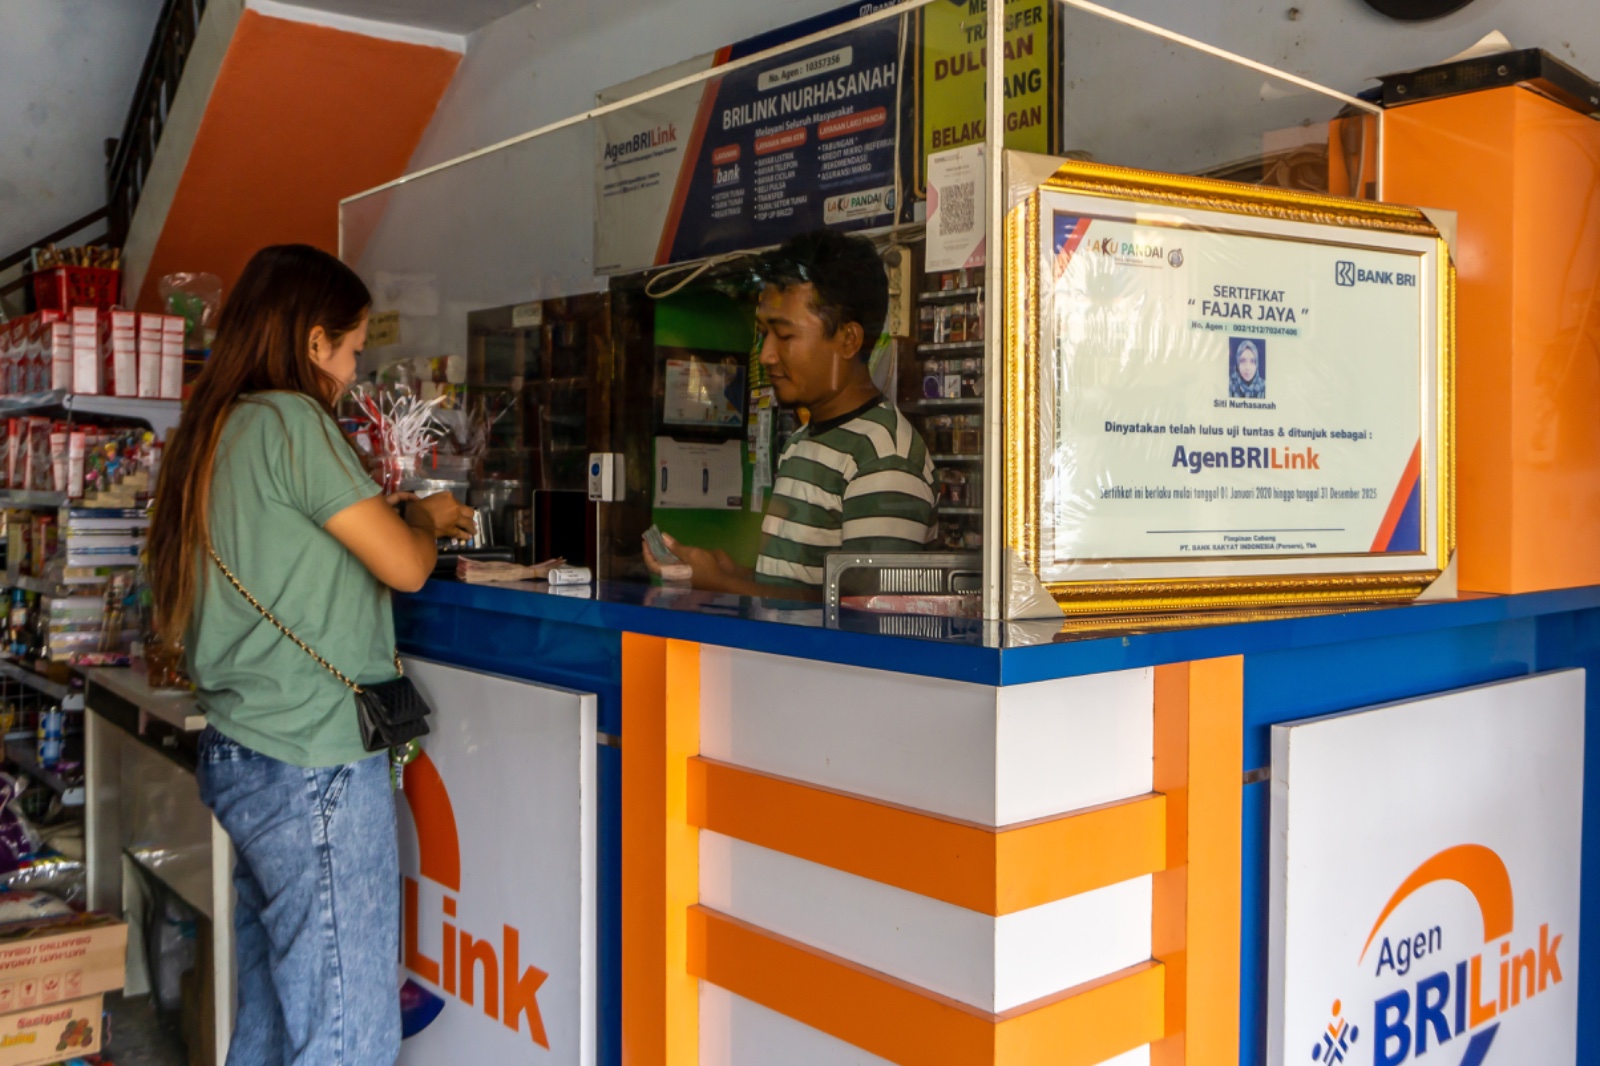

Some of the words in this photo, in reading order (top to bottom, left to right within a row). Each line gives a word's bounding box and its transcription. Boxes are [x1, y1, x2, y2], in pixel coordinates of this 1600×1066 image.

[966, 6, 1042, 44] TRSFER
[781, 68, 799, 80] Agen
[806, 54, 840, 72] 10357356
[723, 96, 778, 130] BRILINK
[781, 62, 896, 114] NURHASANAH
[984, 68, 1041, 103] ANG
[755, 122, 784, 137] Melayani
[786, 116, 811, 130] Seluruh
[813, 106, 854, 124] Masyarakat
[932, 106, 1041, 148] BELAKGAN
[604, 123, 676, 162] AgenBRILink
[828, 197, 848, 214] LAKU
[851, 193, 882, 207] PANDAI
[1122, 242, 1164, 258] PANDAI
[1357, 269, 1394, 285] BANK
[1396, 272, 1416, 287] BRI
[1212, 285, 1285, 303] SERTIFIKAT
[1202, 301, 1253, 320] FAJAR
[1257, 305, 1296, 323] JAYA
[1204, 322, 1223, 332] Agen
[1213, 399, 1228, 408] Siti
[1229, 400, 1276, 410] Nurhasanah
[1104, 420, 1166, 436] Dinyatakan
[1169, 424, 1196, 434] telah
[1199, 424, 1224, 436] lulus
[1226, 425, 1240, 438] uji
[1242, 426, 1274, 437] tuntas
[1278, 426, 1285, 438] &
[1288, 427, 1328, 440] ditunjuk
[1330, 428, 1367, 442] sebagai
[1172, 445, 1320, 474] AgenBRILink
[1134, 486, 1144, 500] ini
[1145, 485, 1172, 500] berlaku
[1173, 486, 1192, 500] mulai
[1194, 486, 1220, 502] tanggal
[1230, 486, 1254, 500] Januari
[1256, 486, 1272, 500] 2020
[1273, 486, 1294, 502] hingga
[1296, 486, 1319, 502] tanggal
[1330, 487, 1360, 500] Desember
[1376, 925, 1442, 976] Agen
[1373, 922, 1564, 1066] BRILink
